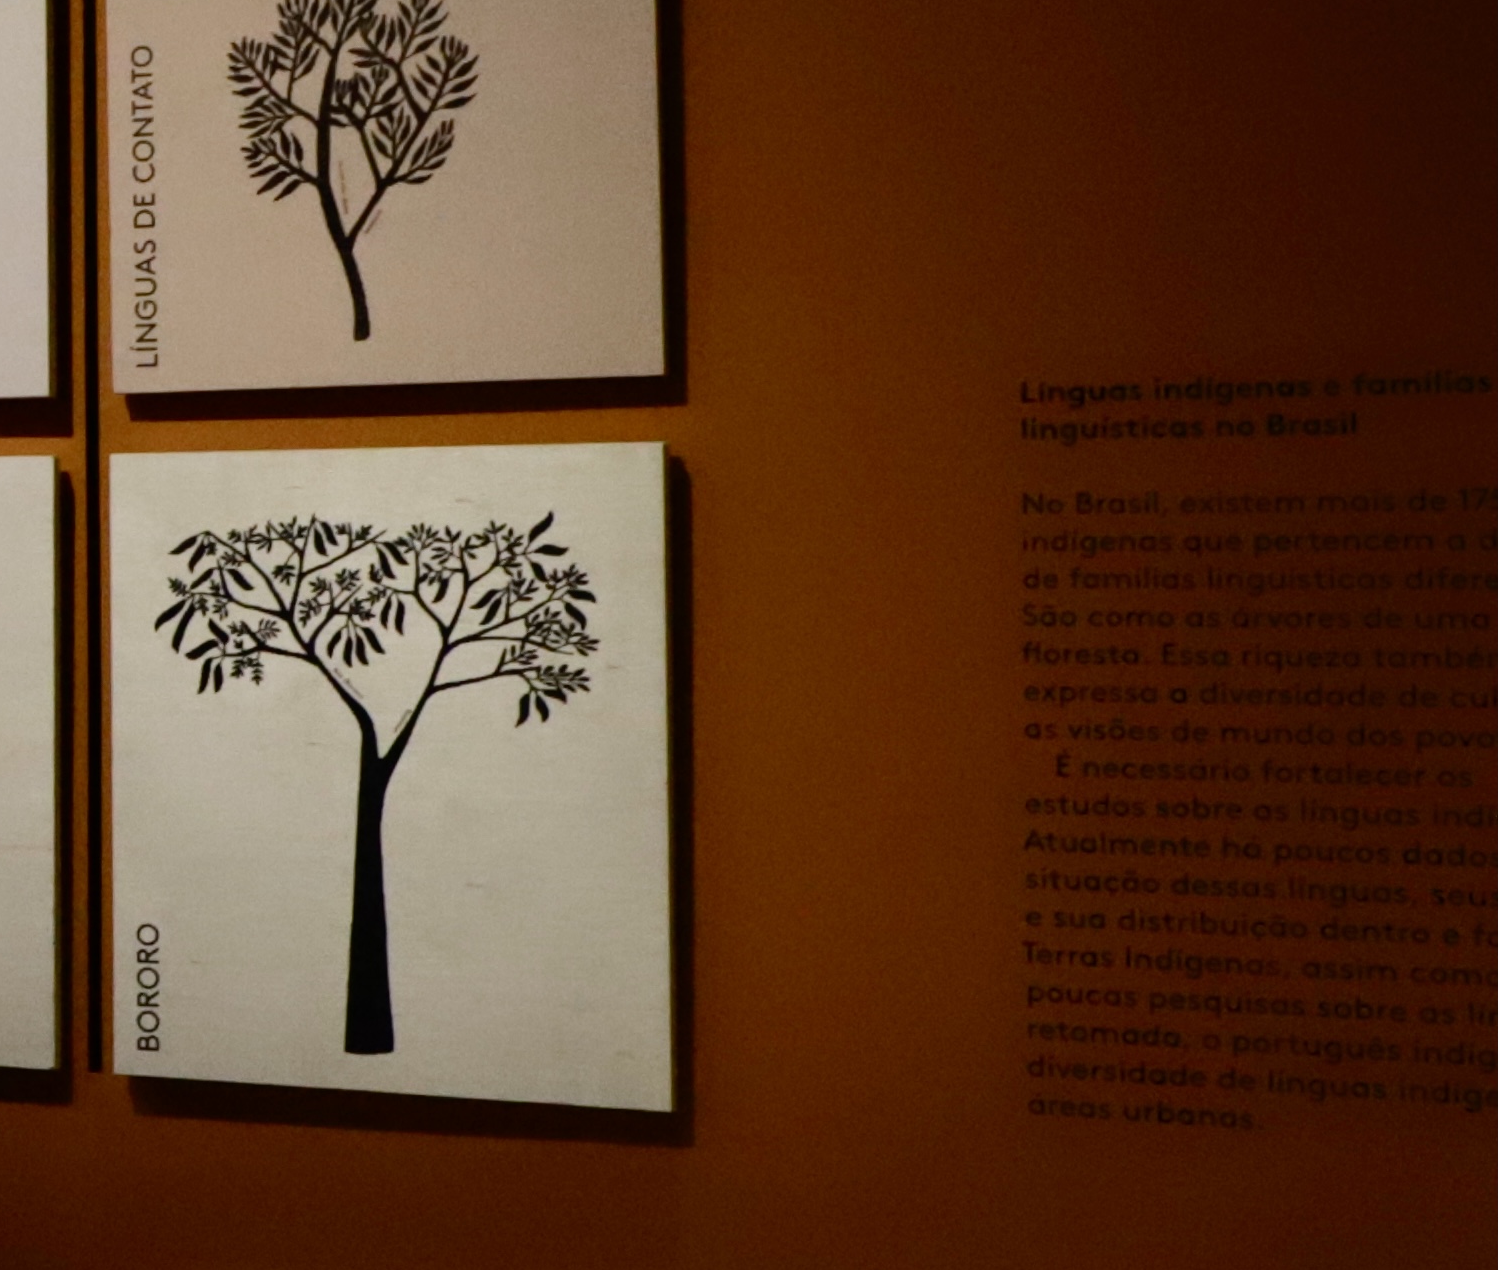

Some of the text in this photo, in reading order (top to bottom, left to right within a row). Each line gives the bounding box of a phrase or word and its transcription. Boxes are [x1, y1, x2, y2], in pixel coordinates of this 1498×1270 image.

[131, 45, 159, 368] LÍNGUAS DE CONTATO
[1324, 376, 1341, 397] e
[1216, 418, 1256, 438] no
[1266, 412, 1358, 436] Brasil
[1021, 491, 1064, 515] No
[1075, 491, 1168, 517] Brasil,
[1178, 491, 1305, 514] existem
[1317, 491, 1397, 513] mais
[1407, 488, 1448, 512] de
[1182, 534, 1243, 558] que
[1253, 532, 1434, 557] pertencem
[1447, 535, 1466, 552] a
[1021, 567, 1060, 591] de
[1021, 602, 1078, 628] São
[1087, 608, 1175, 628] como
[1184, 609, 1220, 628] as
[1363, 604, 1403, 629] de
[1414, 610, 1490, 630] uma
[1161, 642, 1230, 667] Essa
[1239, 646, 1361, 673] riqueza
[1023, 684, 1158, 708] expressa
[1169, 686, 1188, 704] a
[1198, 682, 1386, 708] diversidade
[1398, 684, 1438, 708] de
[1023, 722, 1058, 741] as
[1066, 717, 1161, 742] visões
[1170, 718, 1208, 743] de
[1220, 719, 1336, 746] mundo
[1346, 722, 1404, 747] dos
[1055, 749, 1473, 788] É necessário fortalecer os
[1024, 794, 1145, 818] estudos
[1155, 796, 1243, 821] sobre
[1252, 803, 1289, 822] as
[1023, 829, 1211, 858] Atualmente
[1273, 842, 1391, 866] poucos
[1024, 869, 1161, 897] situação
[1170, 872, 1276, 899] dessas
[1024, 910, 1043, 927] e
[1054, 911, 1107, 929] sua
[1117, 908, 1307, 941] distribuição
[1319, 918, 1431, 946] dentro
[1444, 929, 1461, 946] e
[1021, 940, 1113, 968] Terras
[1305, 957, 1398, 983] assim
[135, 923, 161, 1052] BORORO
[1027, 984, 1138, 1009] poucas
[1148, 989, 1306, 1020] pesquisas
[1317, 996, 1408, 1023] sobre
[1418, 1006, 1456, 1025] as
[1027, 1021, 1190, 1052] retomada,
[1203, 1032, 1221, 1050] o
[1231, 1033, 1402, 1065] português
[1027, 1055, 1208, 1088] diversidade
[1218, 1064, 1257, 1091] de
